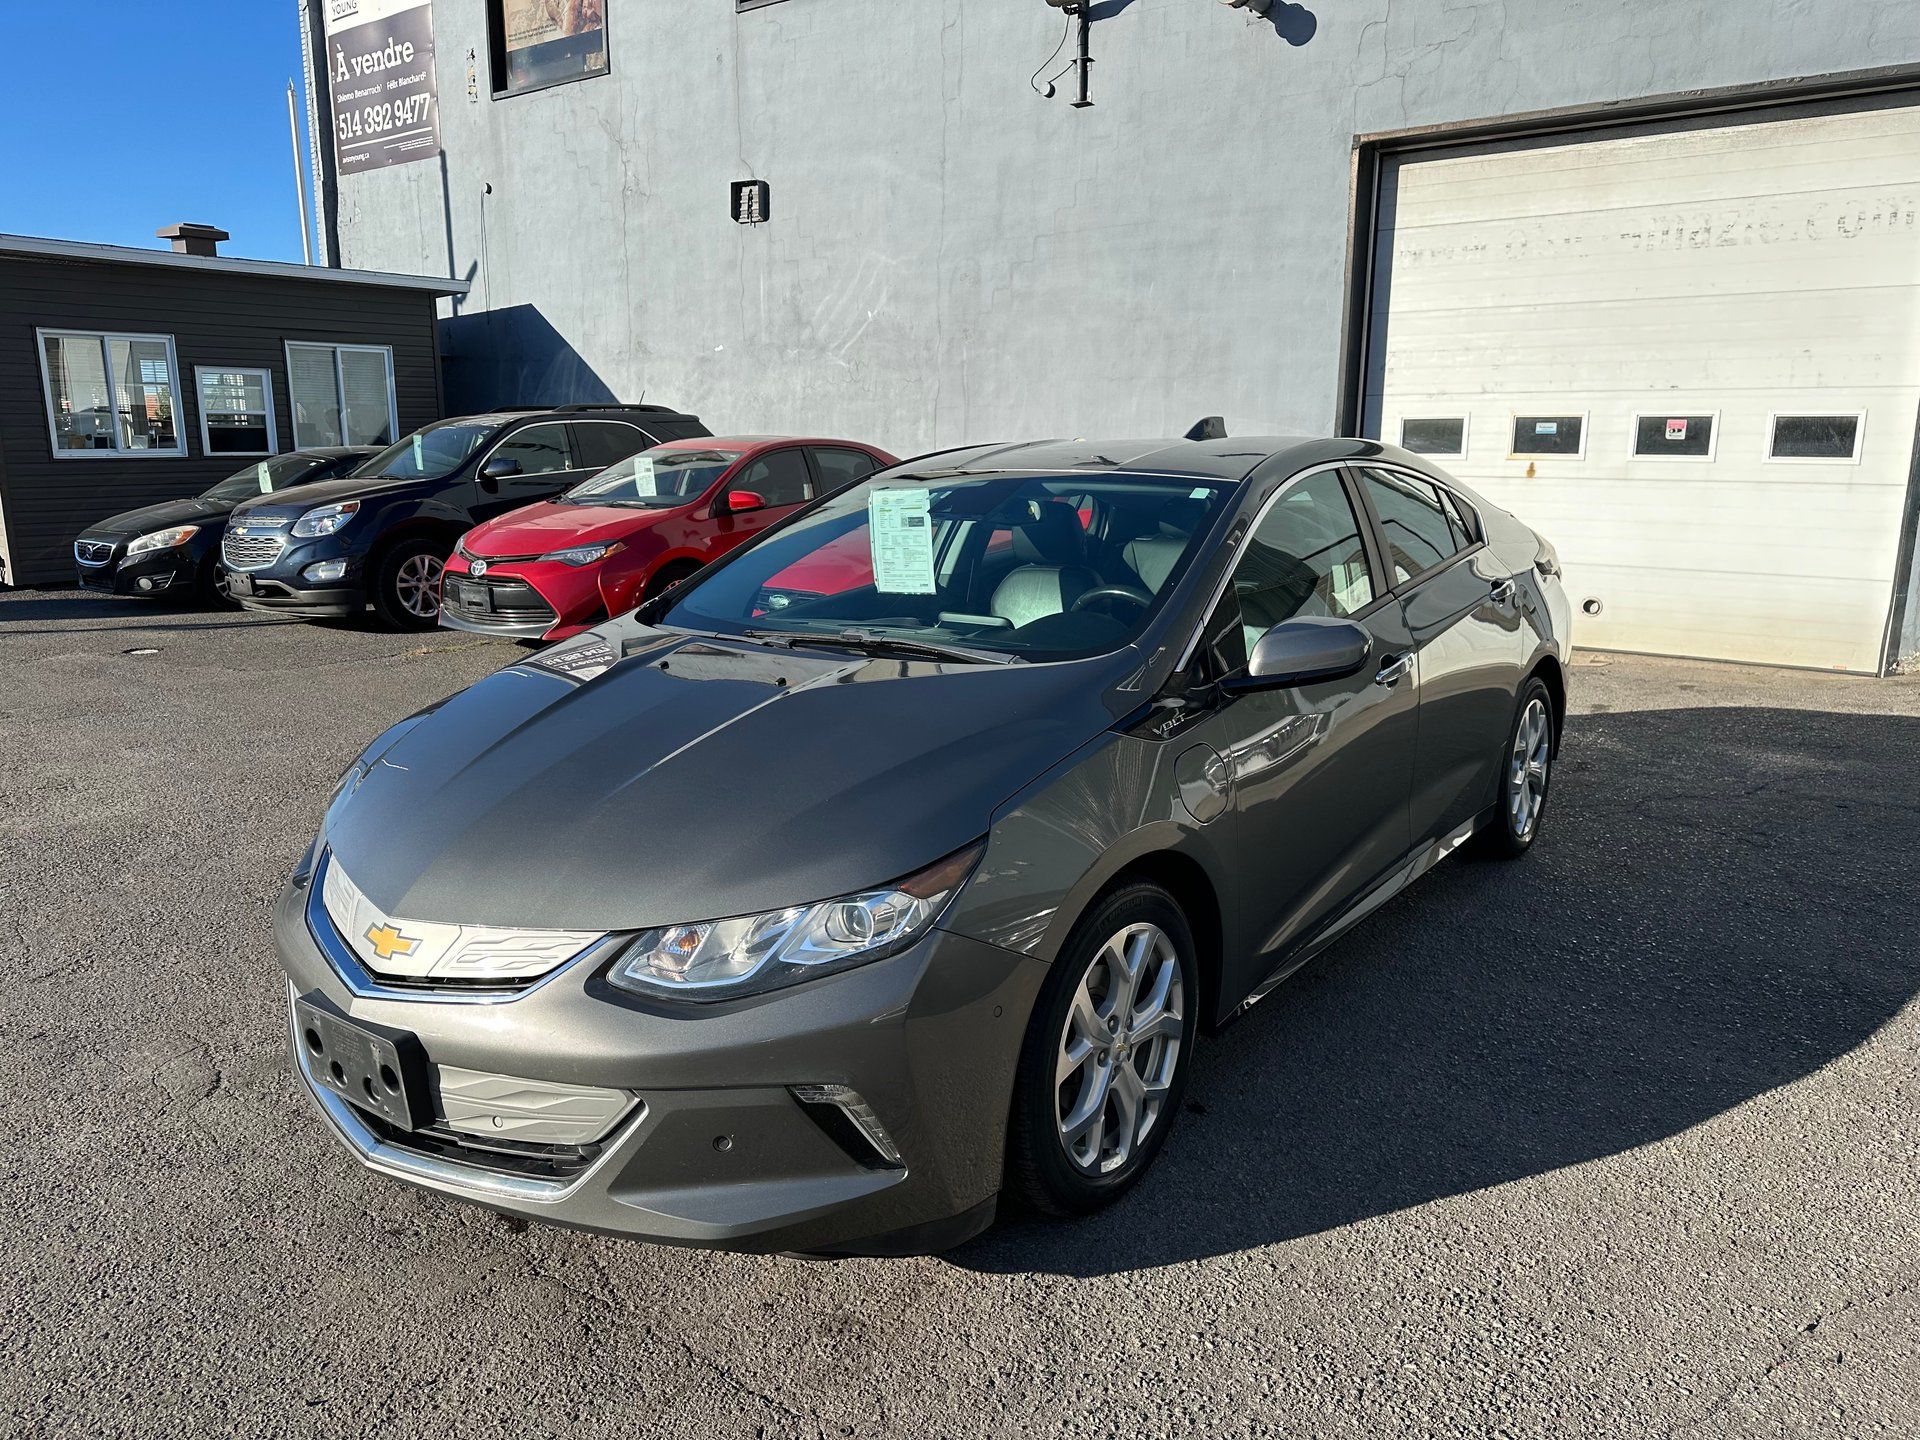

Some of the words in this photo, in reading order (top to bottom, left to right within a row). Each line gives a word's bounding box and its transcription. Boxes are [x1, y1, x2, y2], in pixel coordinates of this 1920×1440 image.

[332, 0, 357, 16] YOUNG
[336, 43, 350, 82] À
[351, 36, 414, 77] vendre
[339, 109, 362, 140] 514
[364, 102, 392, 134] 392
[394, 92, 430, 127] 9477
[1152, 712, 1186, 735] VOLT
